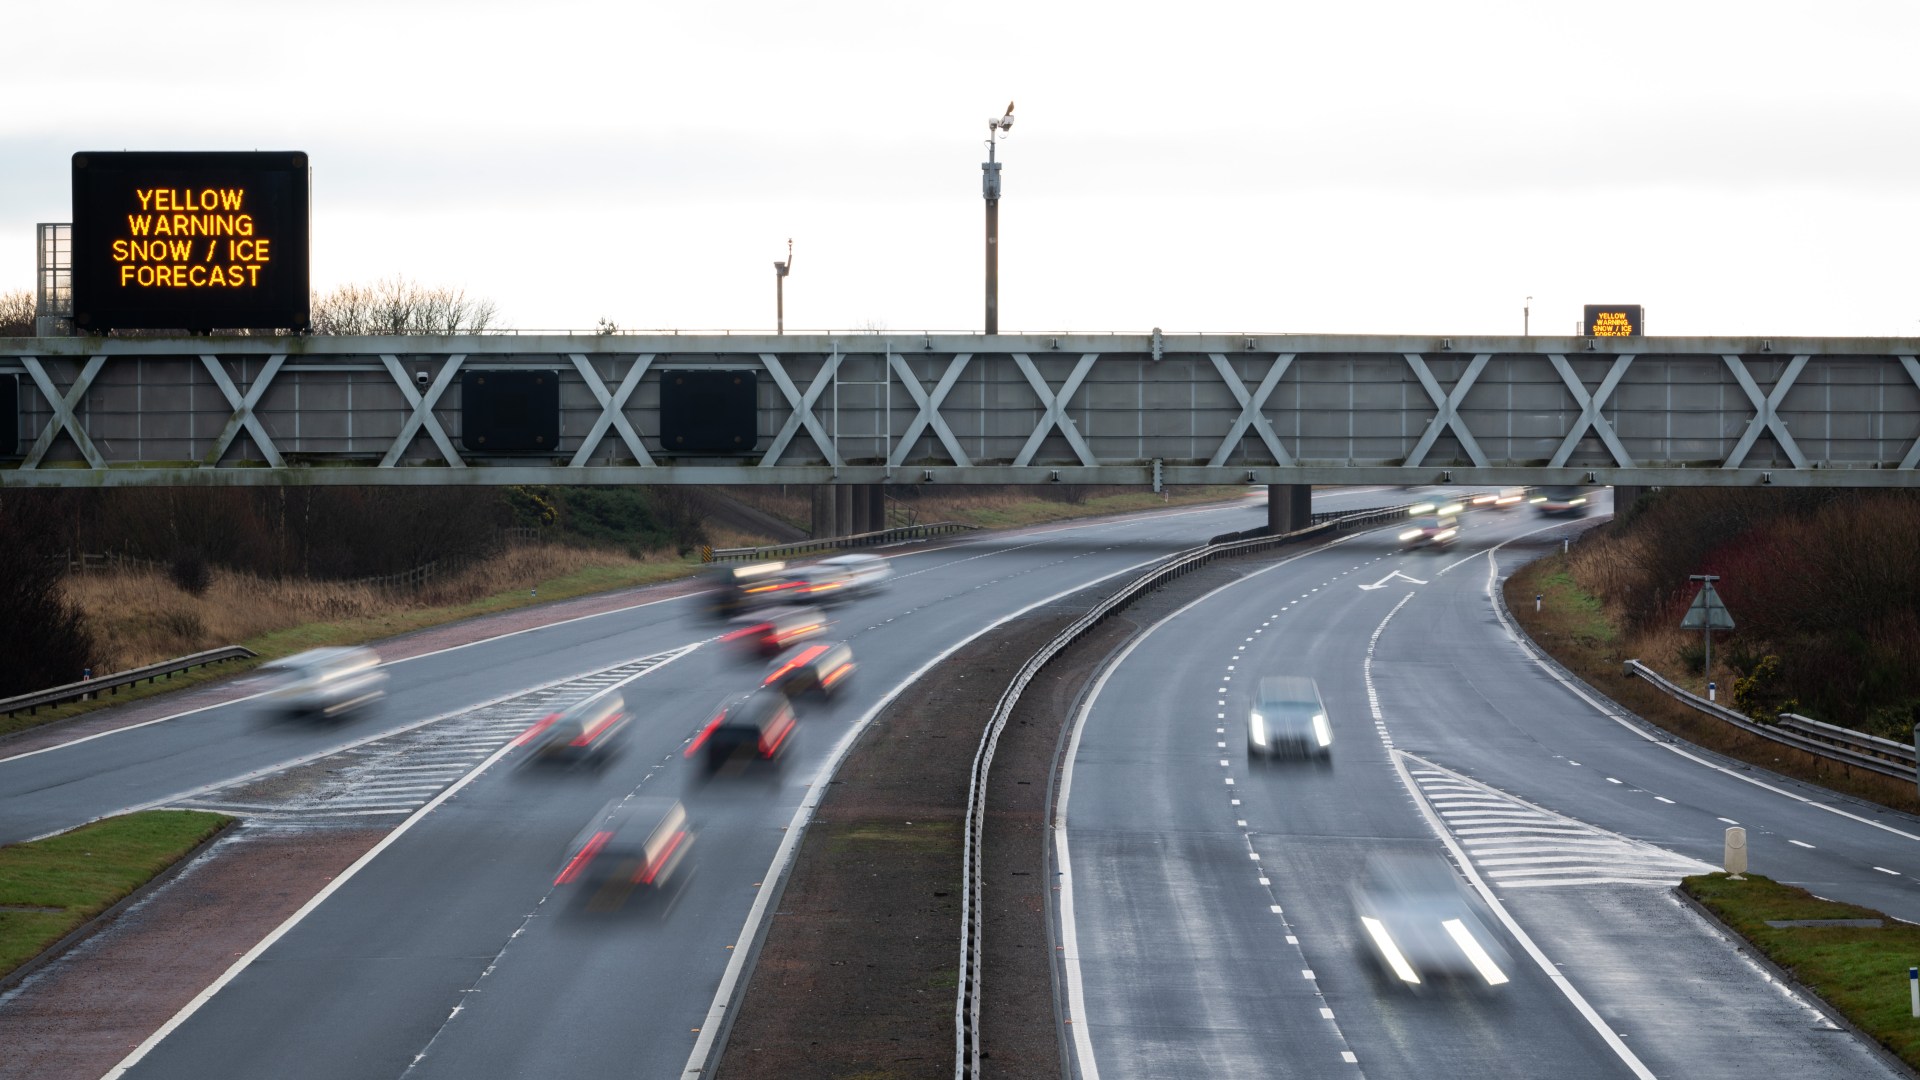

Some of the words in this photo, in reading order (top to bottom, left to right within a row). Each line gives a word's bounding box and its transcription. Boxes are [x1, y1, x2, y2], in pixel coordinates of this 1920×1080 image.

[137, 189, 243, 211] YELLOW
[128, 215, 253, 236] WARNING
[112, 240, 192, 262] SNOW
[206, 240, 217, 262] /
[230, 240, 270, 262] ICE
[121, 265, 261, 287] FORECAST
